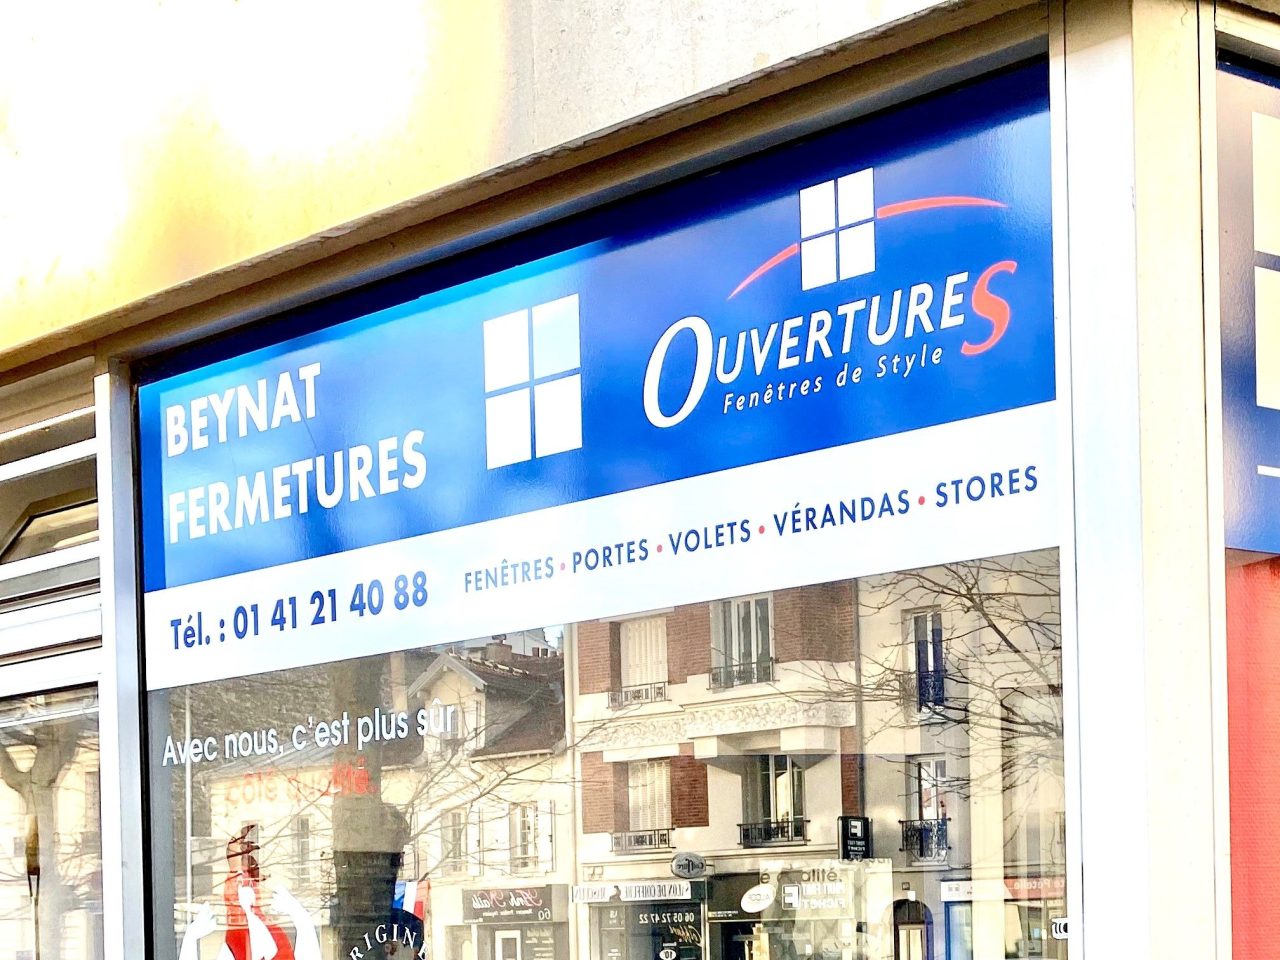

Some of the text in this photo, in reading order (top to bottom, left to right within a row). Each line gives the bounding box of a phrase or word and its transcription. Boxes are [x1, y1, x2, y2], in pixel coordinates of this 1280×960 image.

[642, 260, 1018, 429] OUVERTURES
[722, 344, 943, 414] Fenêtres de Style
[166, 363, 321, 458] BEYNAT
[168, 430, 427, 544] FERMETURES
[464, 465, 1039, 593] FENÊTRES PORTES VOLETS VÉRANDAS STORES
[233, 604, 261, 640] 01
[270, 597, 298, 634] 41
[310, 589, 338, 627] 21
[349, 582, 385, 618] 40
[399, 571, 428, 609] 88
[162, 697, 455, 767] Avec nous, c'est plus sûr
